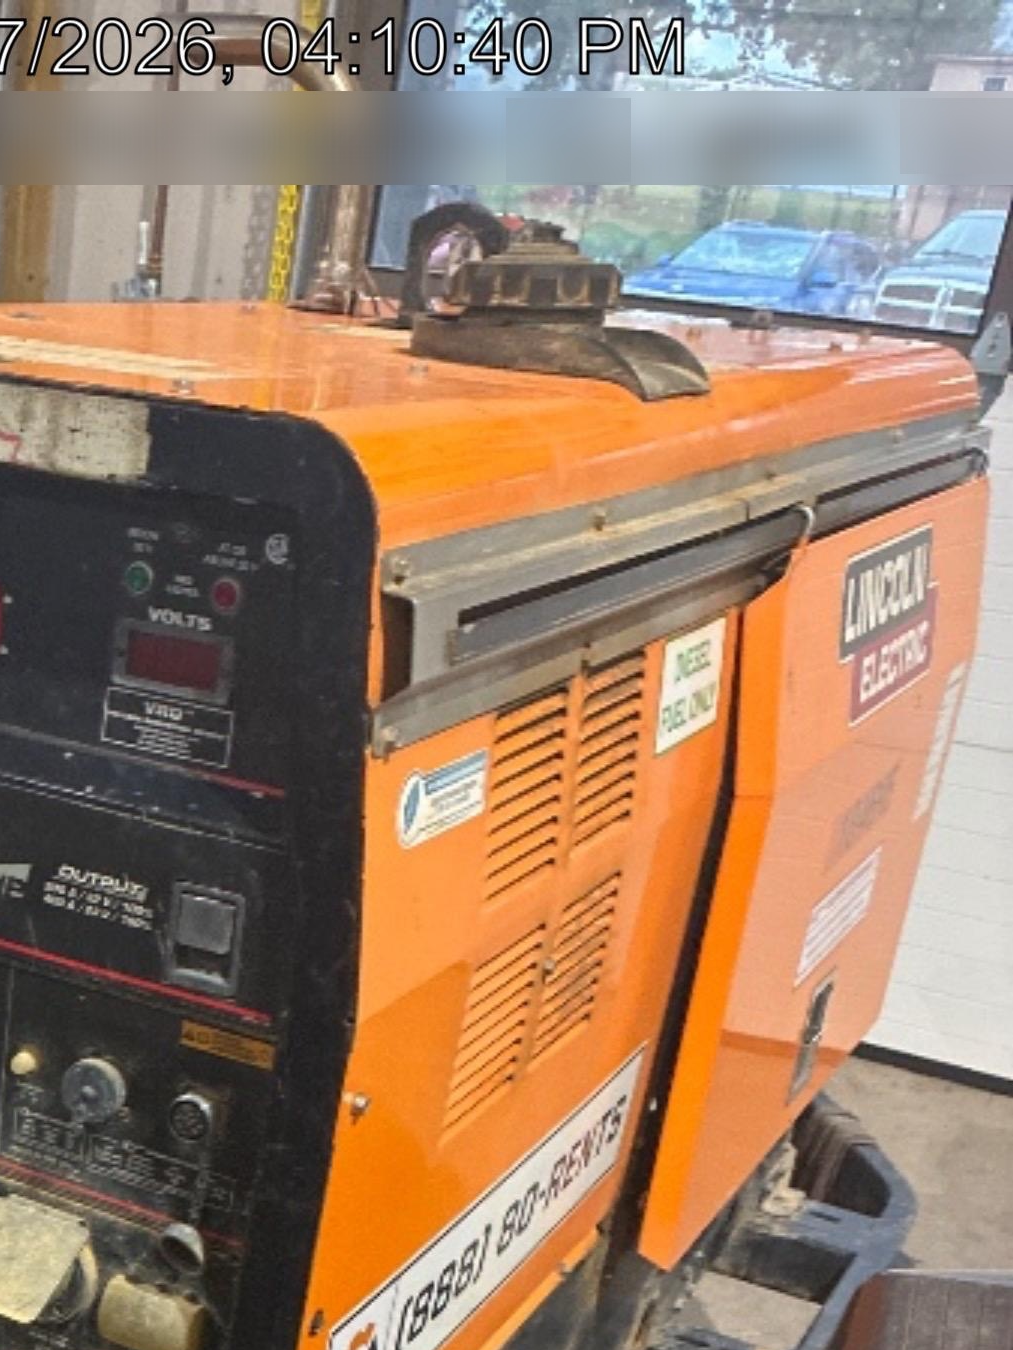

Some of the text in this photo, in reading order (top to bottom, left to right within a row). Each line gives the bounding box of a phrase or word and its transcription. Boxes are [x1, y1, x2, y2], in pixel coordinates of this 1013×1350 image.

[147, 605, 213, 632] VOLTS
[844, 541, 932, 643] LINCOLN
[859, 619, 931, 704] ELECTRIC
[496, 1094, 628, 1257] 80-RENTS
